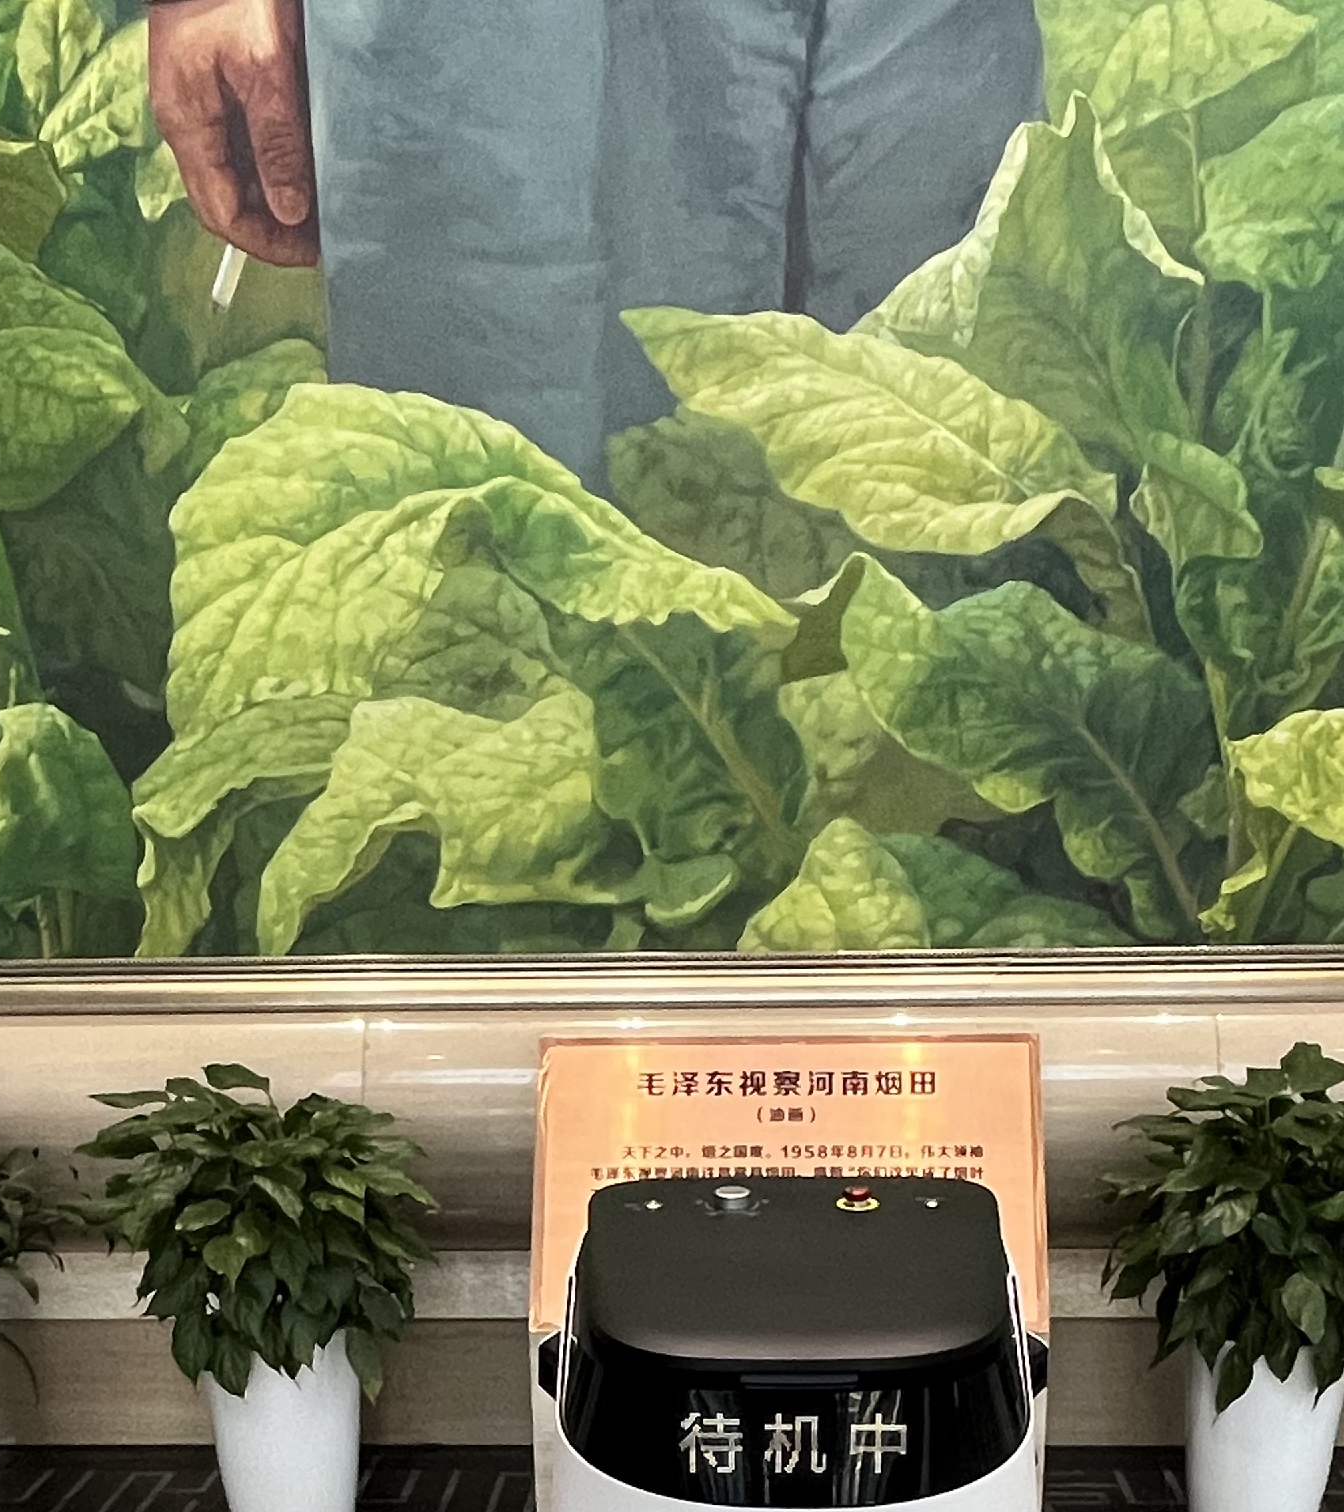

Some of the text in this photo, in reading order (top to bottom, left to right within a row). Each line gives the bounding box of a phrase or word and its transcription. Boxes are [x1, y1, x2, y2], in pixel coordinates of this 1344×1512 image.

[638, 1070, 938, 1097] 毛泽东视察河南烟田
[679, 1412, 908, 1474] 待机中
